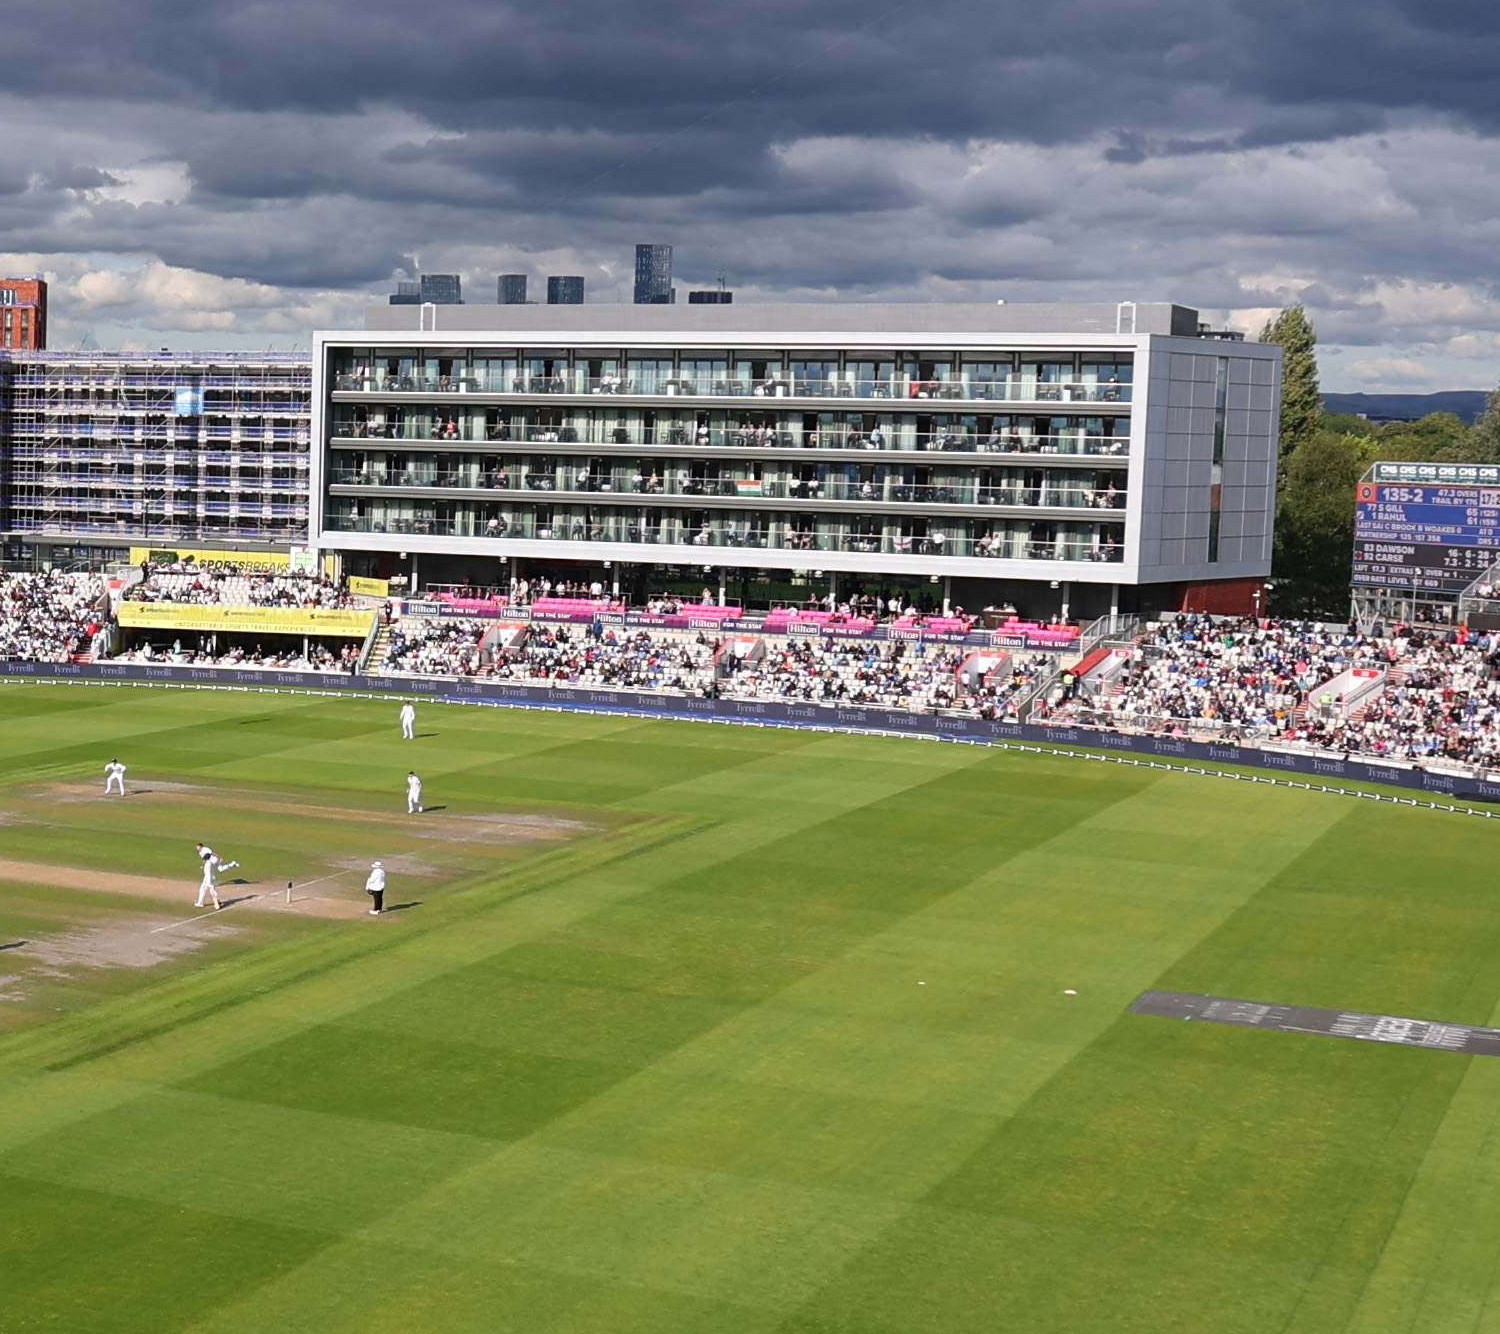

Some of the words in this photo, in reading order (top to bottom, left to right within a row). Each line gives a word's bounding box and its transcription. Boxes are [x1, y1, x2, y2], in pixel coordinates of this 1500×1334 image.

[1382, 487, 1423, 502] 135-2
[1367, 503, 1377, 511] 77
[1386, 505, 1404, 513] GILL
[1466, 508, 1478, 516] 65
[1467, 517, 1478, 525] 61
[1376, 544, 1415, 554] DAWSON
[1375, 554, 1404, 563] CARSE
[411, 603, 437, 615] Hilton
[596, 613, 623, 624] Hilton
[691, 618, 718, 629] Hilton
[790, 623, 818, 635] Hilton
[992, 635, 1022, 647] Hilton
[1045, 727, 1078, 742] Tyrrells
[1262, 751, 1295, 768] Tyrrells
